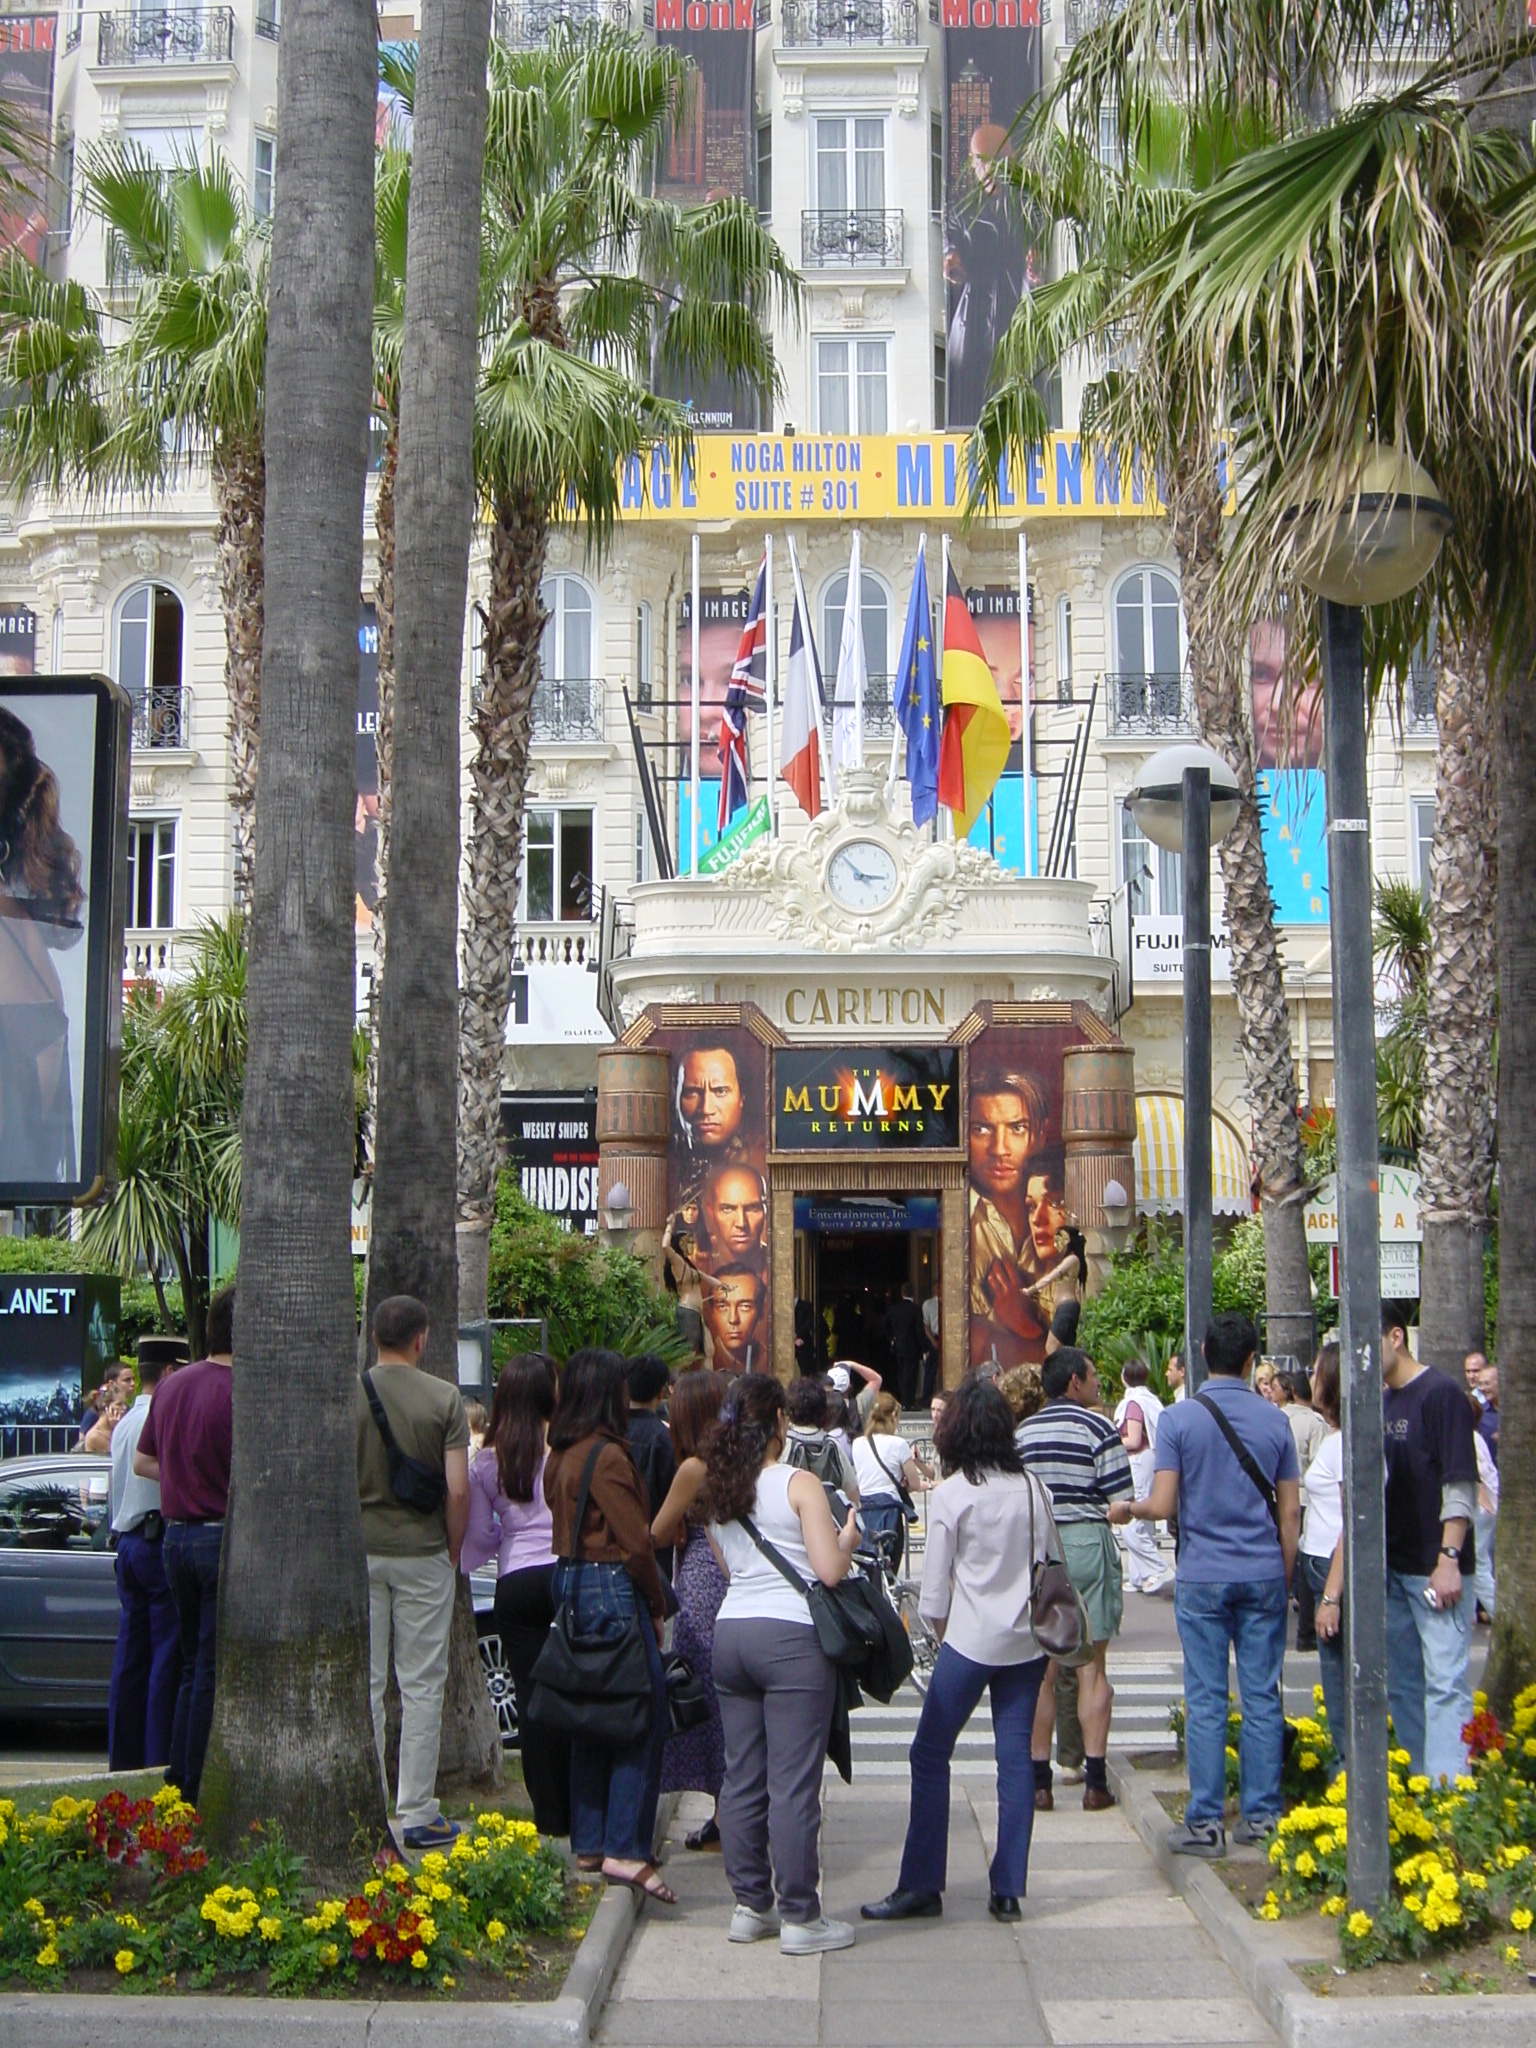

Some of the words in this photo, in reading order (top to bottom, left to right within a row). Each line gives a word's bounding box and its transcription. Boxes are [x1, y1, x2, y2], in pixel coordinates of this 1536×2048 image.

[731, 442, 785, 472] NOGA
[792, 442, 862, 472] HILTON
[735, 480, 792, 511] SUITE
[800, 483, 813, 511] #
[822, 480, 858, 511] 301
[705, 601, 748, 618] IMAGE
[1136, 934, 1226, 950] FUJIM
[785, 988, 945, 1025] CARLTON
[852, 1069, 881, 1078] THE
[783, 1079, 950, 1116] MUMMY
[522, 1121, 556, 1139] WESLEY
[558, 1121, 589, 1139] SNIPES
[812, 1121, 925, 1133] RETURNS
